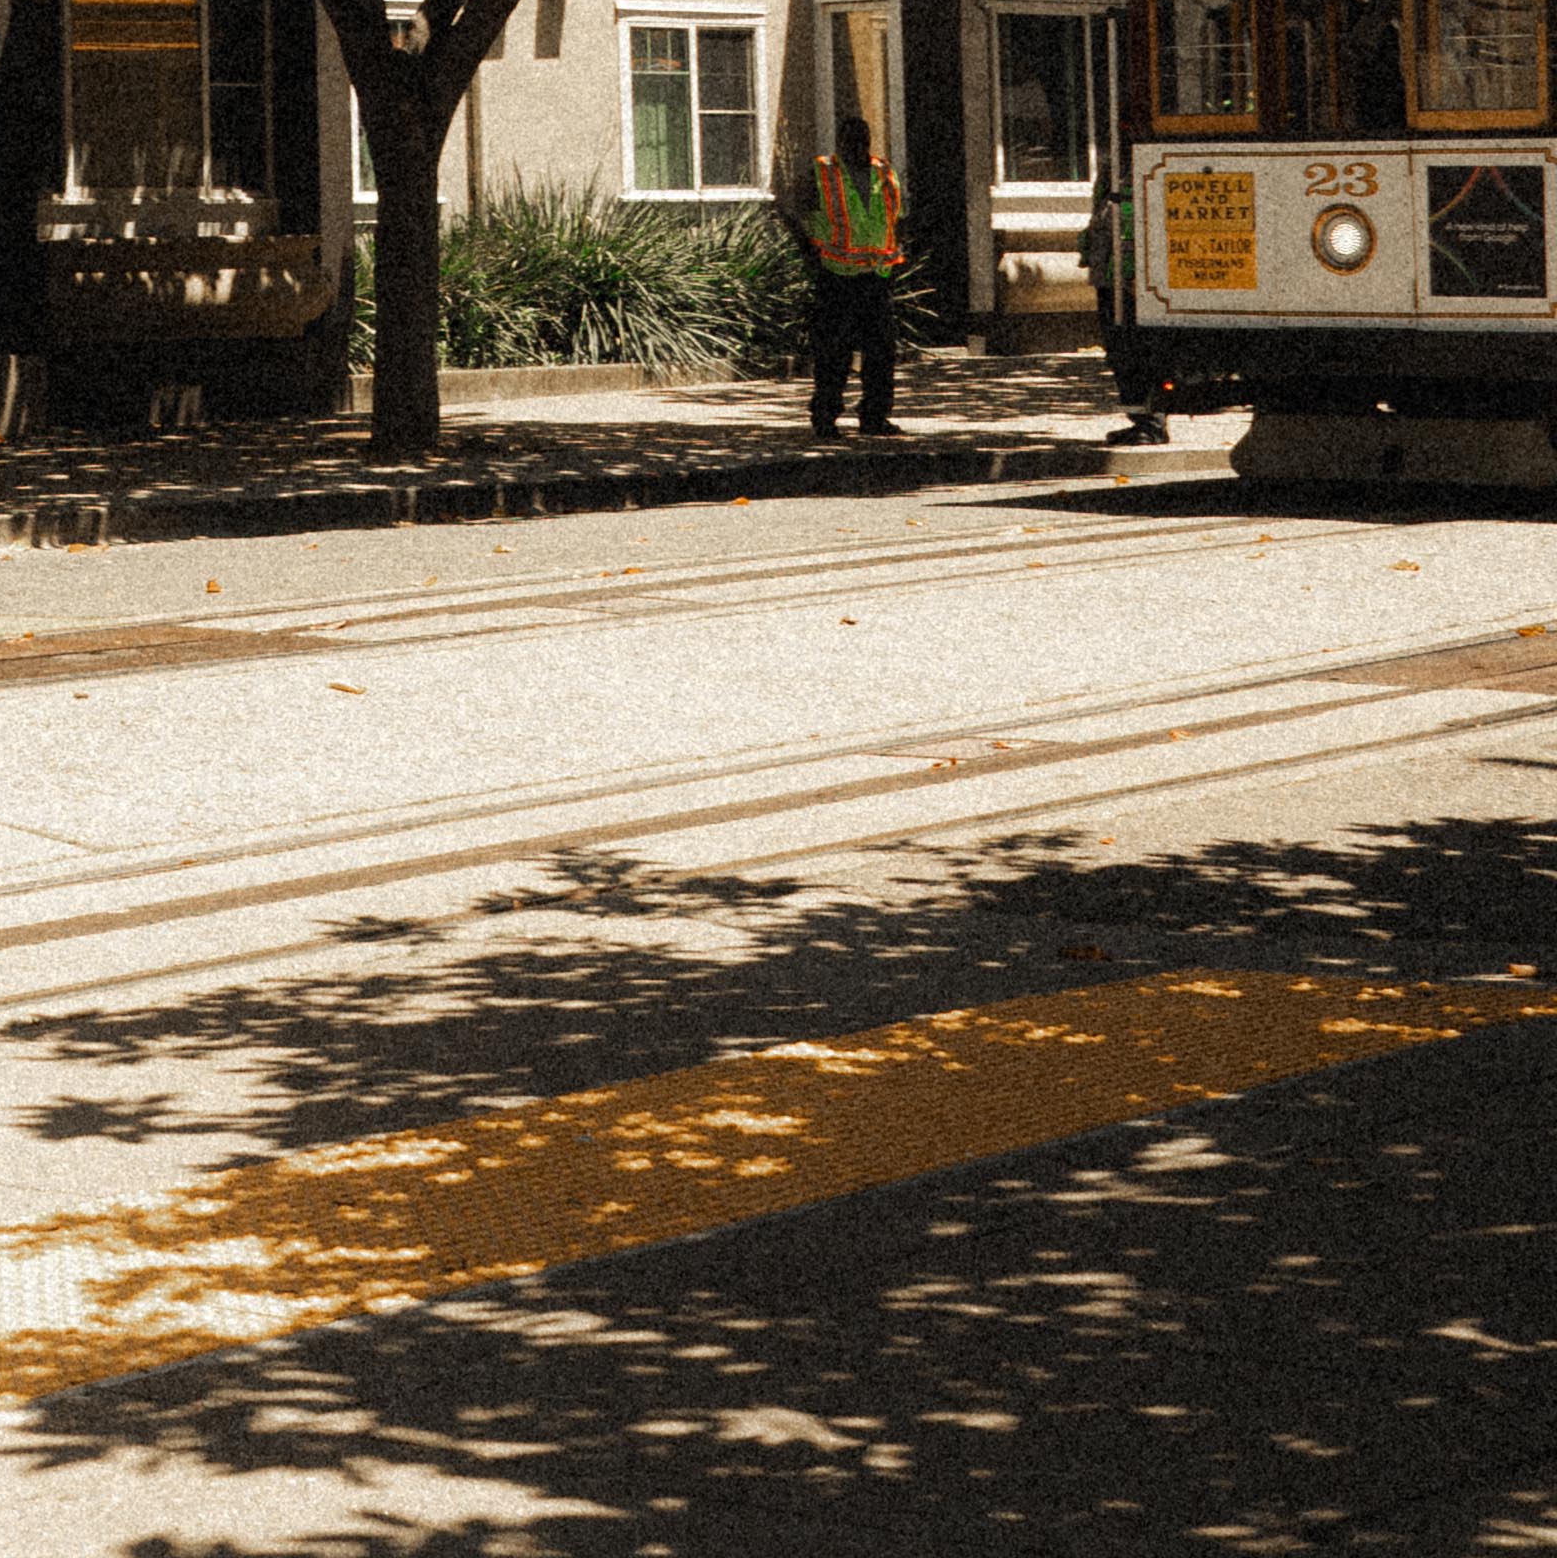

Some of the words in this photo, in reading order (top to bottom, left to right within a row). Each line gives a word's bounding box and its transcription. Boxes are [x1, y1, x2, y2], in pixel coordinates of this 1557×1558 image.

[1168, 180, 1248, 194] POWELL
[1303, 162, 1379, 198] 23
[1190, 194, 1228, 204] AND
[1167, 206, 1250, 220] MARKET
[1169, 239, 1190, 254] BAY
[1209, 238, 1252, 254] TAYLOR
